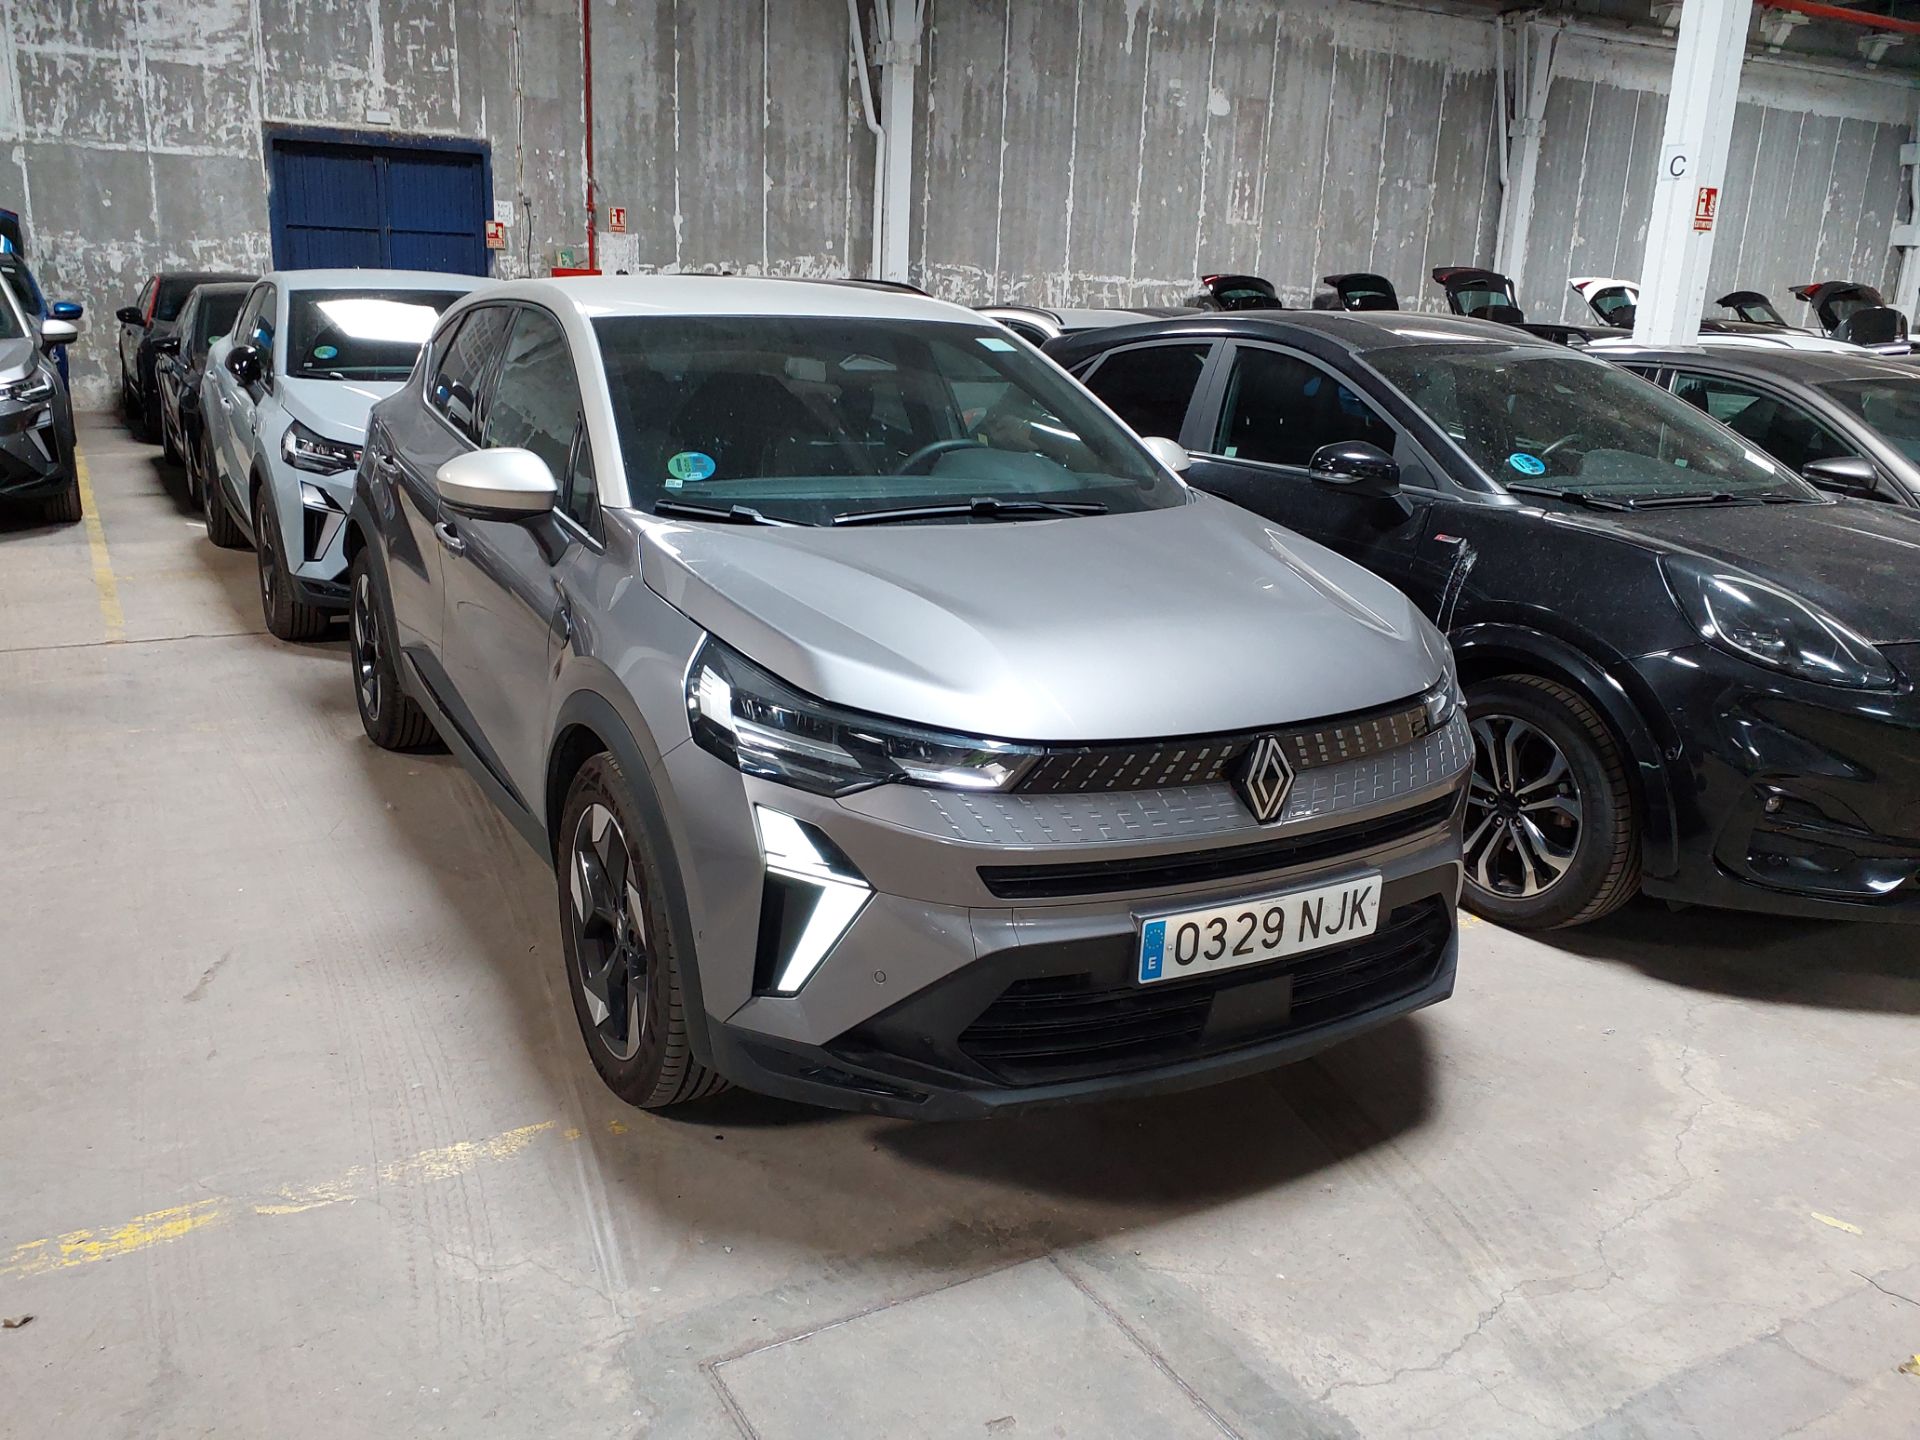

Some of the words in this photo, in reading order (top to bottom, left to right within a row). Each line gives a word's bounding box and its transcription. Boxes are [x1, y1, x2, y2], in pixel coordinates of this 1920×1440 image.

[1669, 155, 1687, 177] C
[1174, 906, 1285, 966] 0329
[1298, 886, 1373, 943] NJK
[1147, 956, 1158, 970] E
